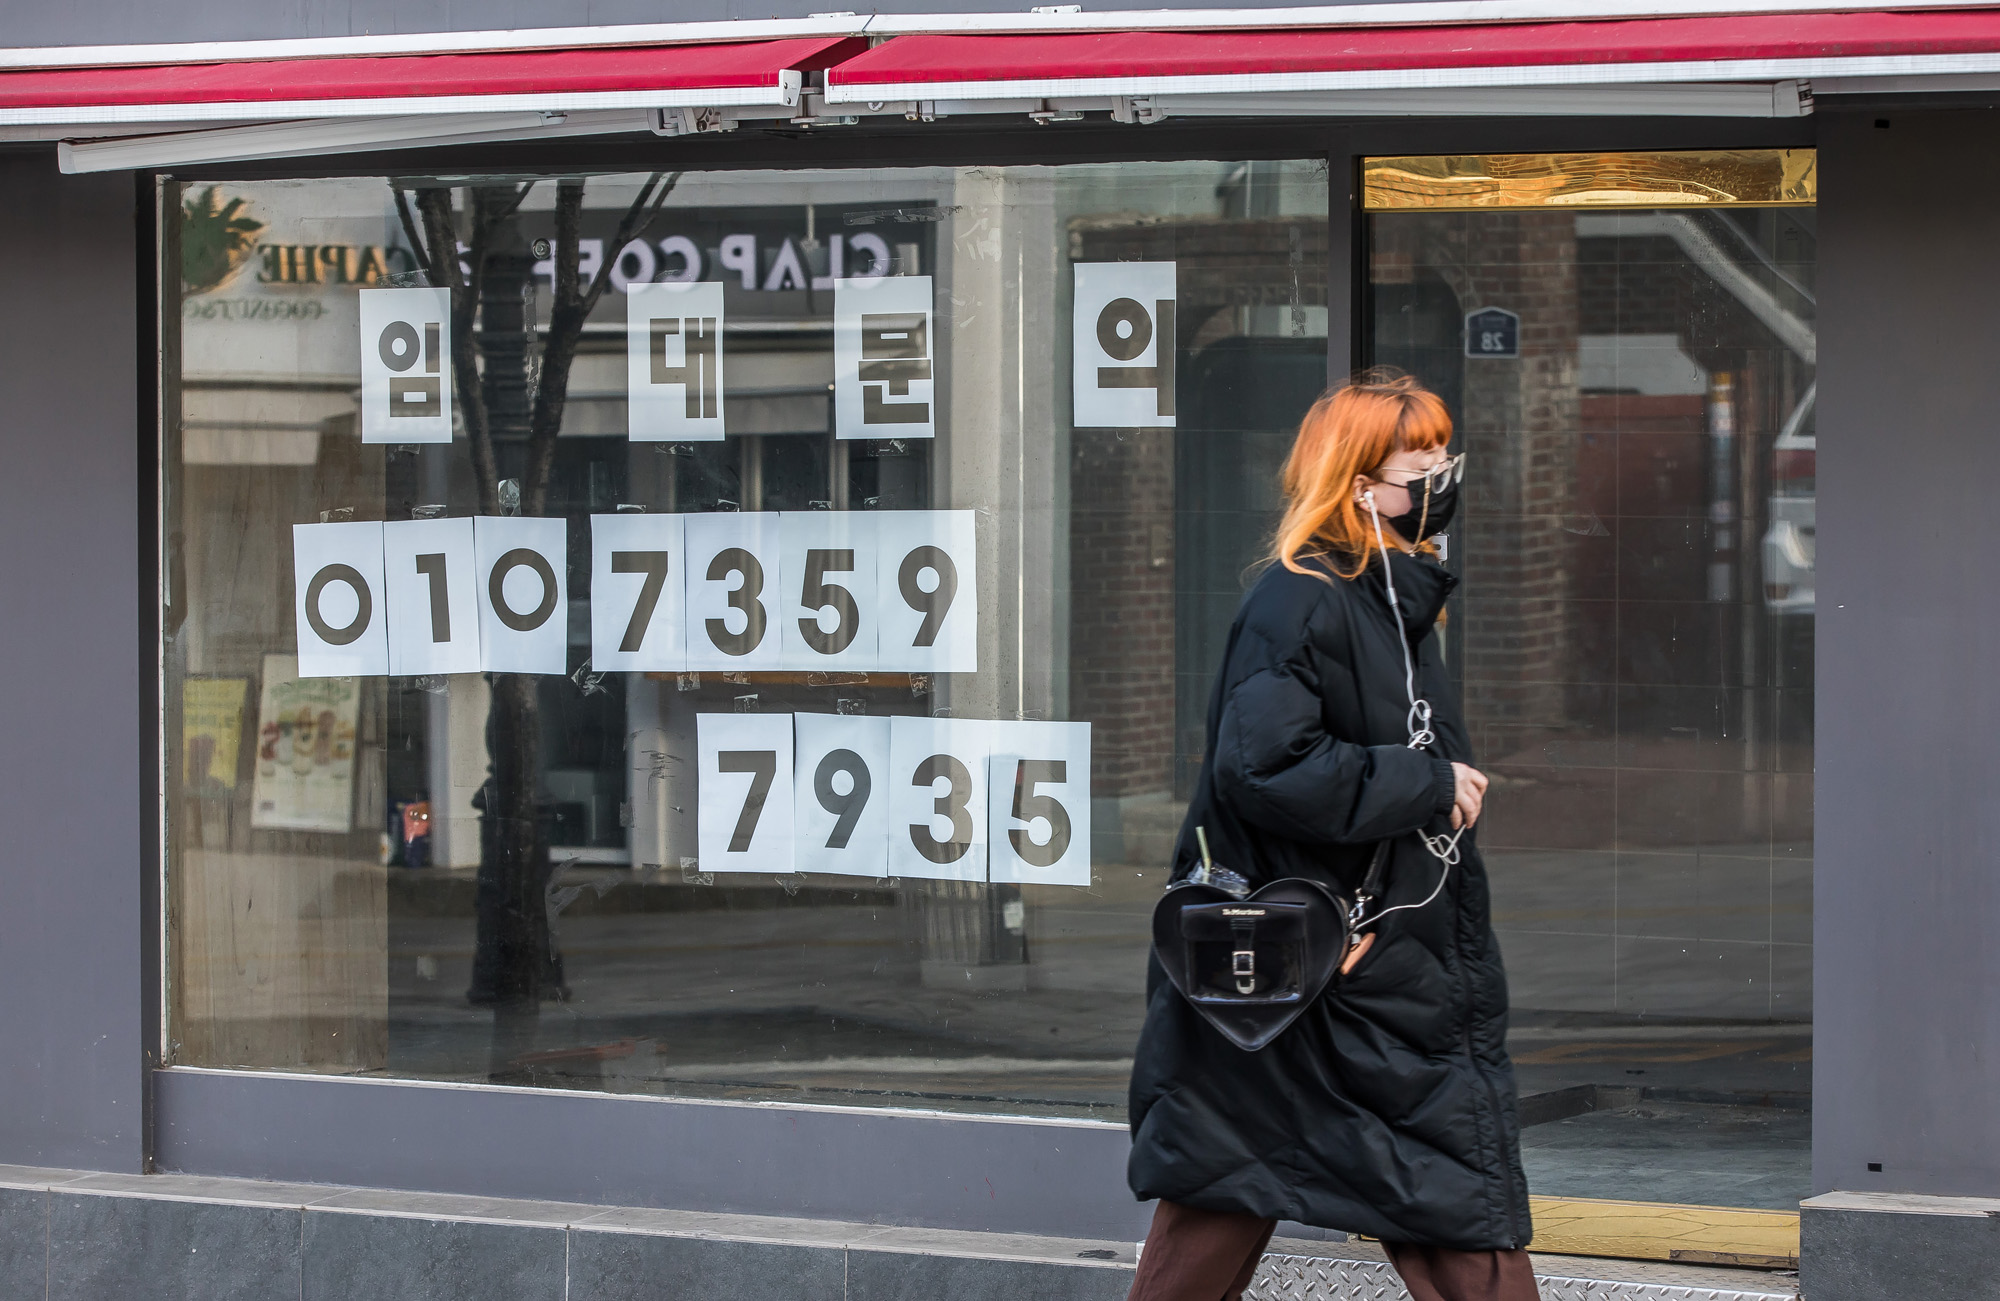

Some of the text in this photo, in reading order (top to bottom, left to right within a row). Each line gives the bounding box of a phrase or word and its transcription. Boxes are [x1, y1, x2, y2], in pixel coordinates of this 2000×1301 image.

[378, 297, 1176, 424] 임 대 문 의
[305, 545, 958, 656] 010 7359
[718, 748, 1072, 867] 7935
